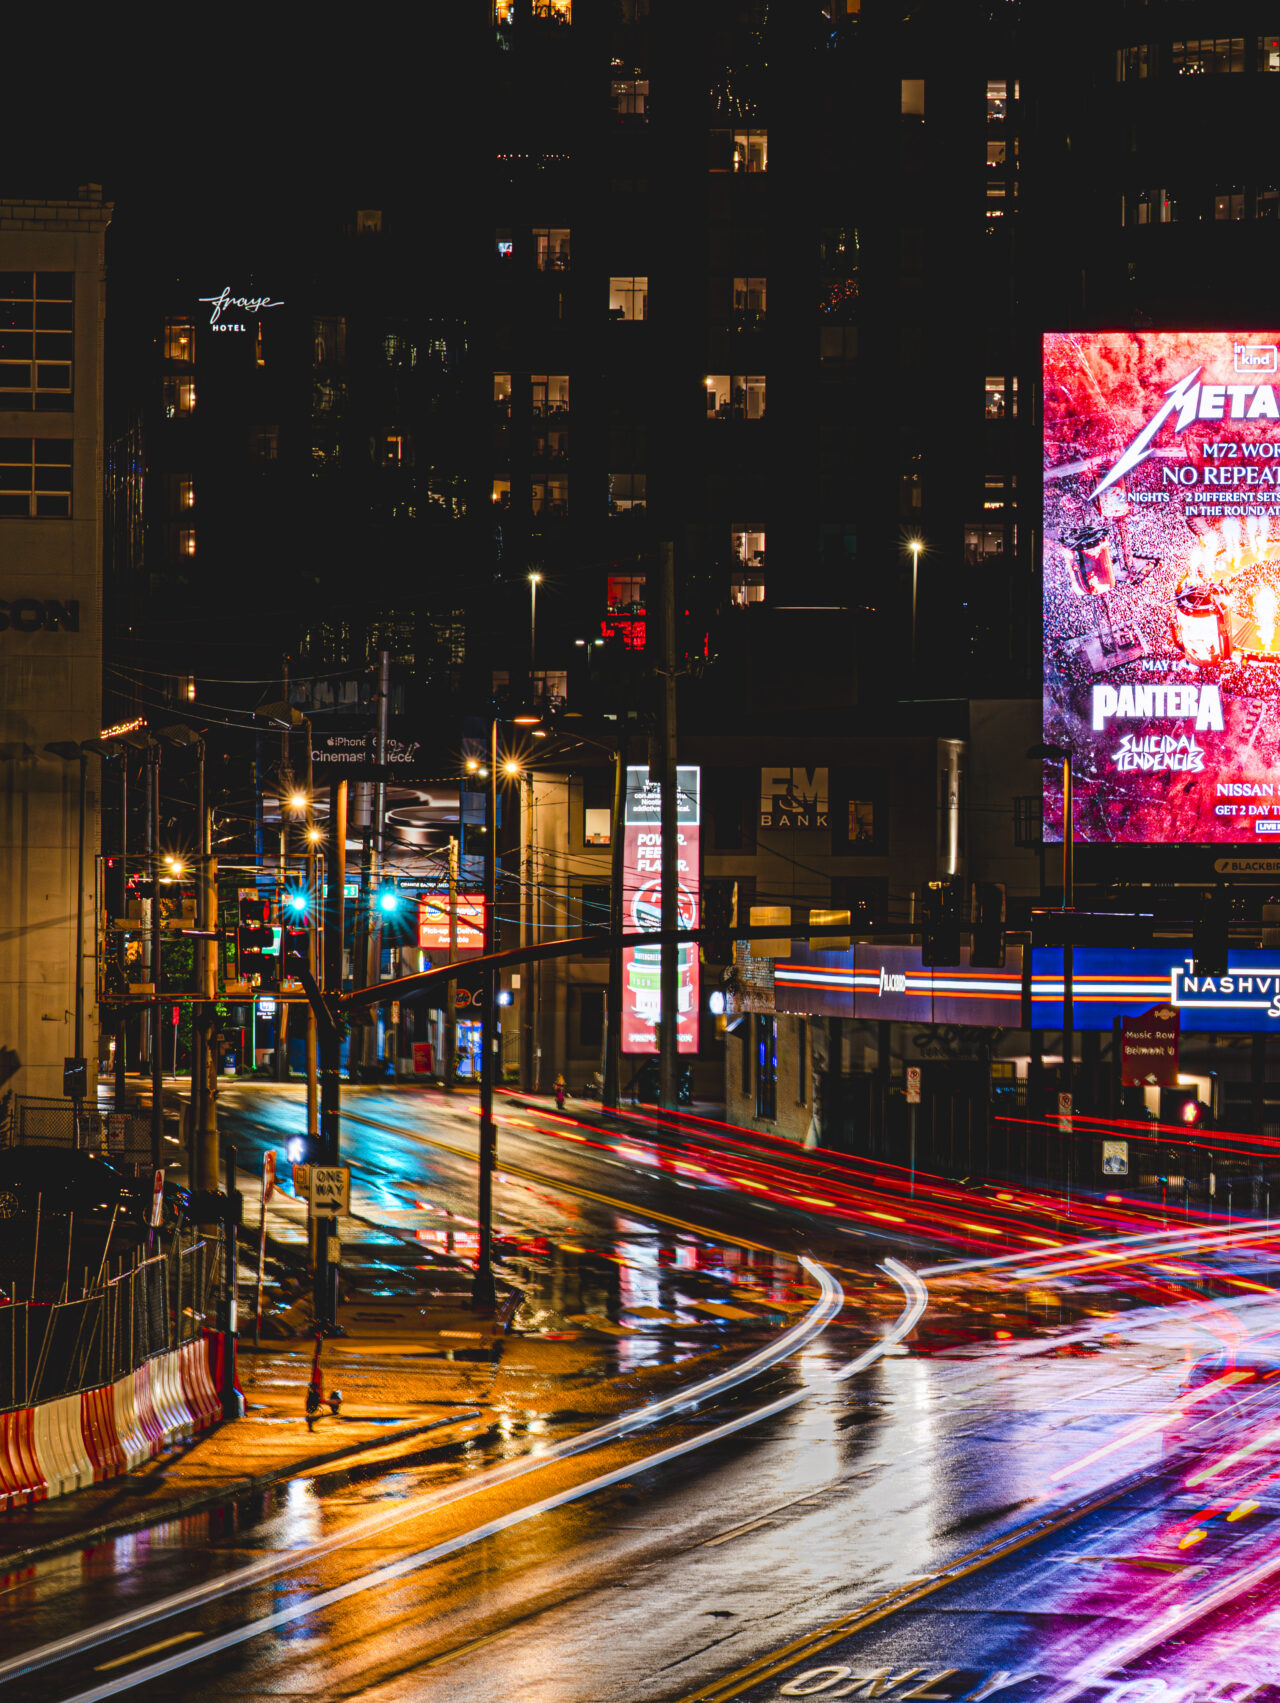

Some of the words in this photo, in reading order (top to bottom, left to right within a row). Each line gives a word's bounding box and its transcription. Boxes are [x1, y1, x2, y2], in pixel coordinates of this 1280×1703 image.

[212, 324, 247, 332] HOTEL
[1234, 342, 1246, 353] in
[1241, 353, 1271, 366] kind
[1203, 443, 1237, 458] M72
[1162, 466, 1199, 485] NO
[1127, 492, 1170, 502] NIGHTS
[1185, 492, 1192, 502] 2
[1194, 492, 1255, 502] DIFFERENT
[1185, 505, 1198, 516] IN
[1200, 505, 1222, 516] THE
[1224, 505, 1265, 516] ROUND
[1266, 505, 1280, 516] AT
[1142, 660, 1168, 671] MAY
[1092, 685, 1225, 731] PANTERA
[1119, 733, 1205, 753] SUICIDAL
[1111, 752, 1206, 773] TENDENCIES
[761, 767, 829, 812] F&M
[1216, 783, 1274, 797] NISSAN
[1214, 805, 1238, 816] GET
[1239, 805, 1247, 816] 2
[1248, 805, 1270, 816] DAY
[761, 814, 828, 827] BANK
[1258, 822, 1277, 831] LIVE
[1125, 1030, 1152, 1039] Music
[1155, 1030, 1175, 1039] Row
[1124, 1045, 1165, 1056] Belmont
[1167, 1046, 1175, 1056] U
[316, 1170, 345, 1184] ONE
[315, 1183, 345, 1197] WAY
[780, 1665, 1043, 1702] ONLY
